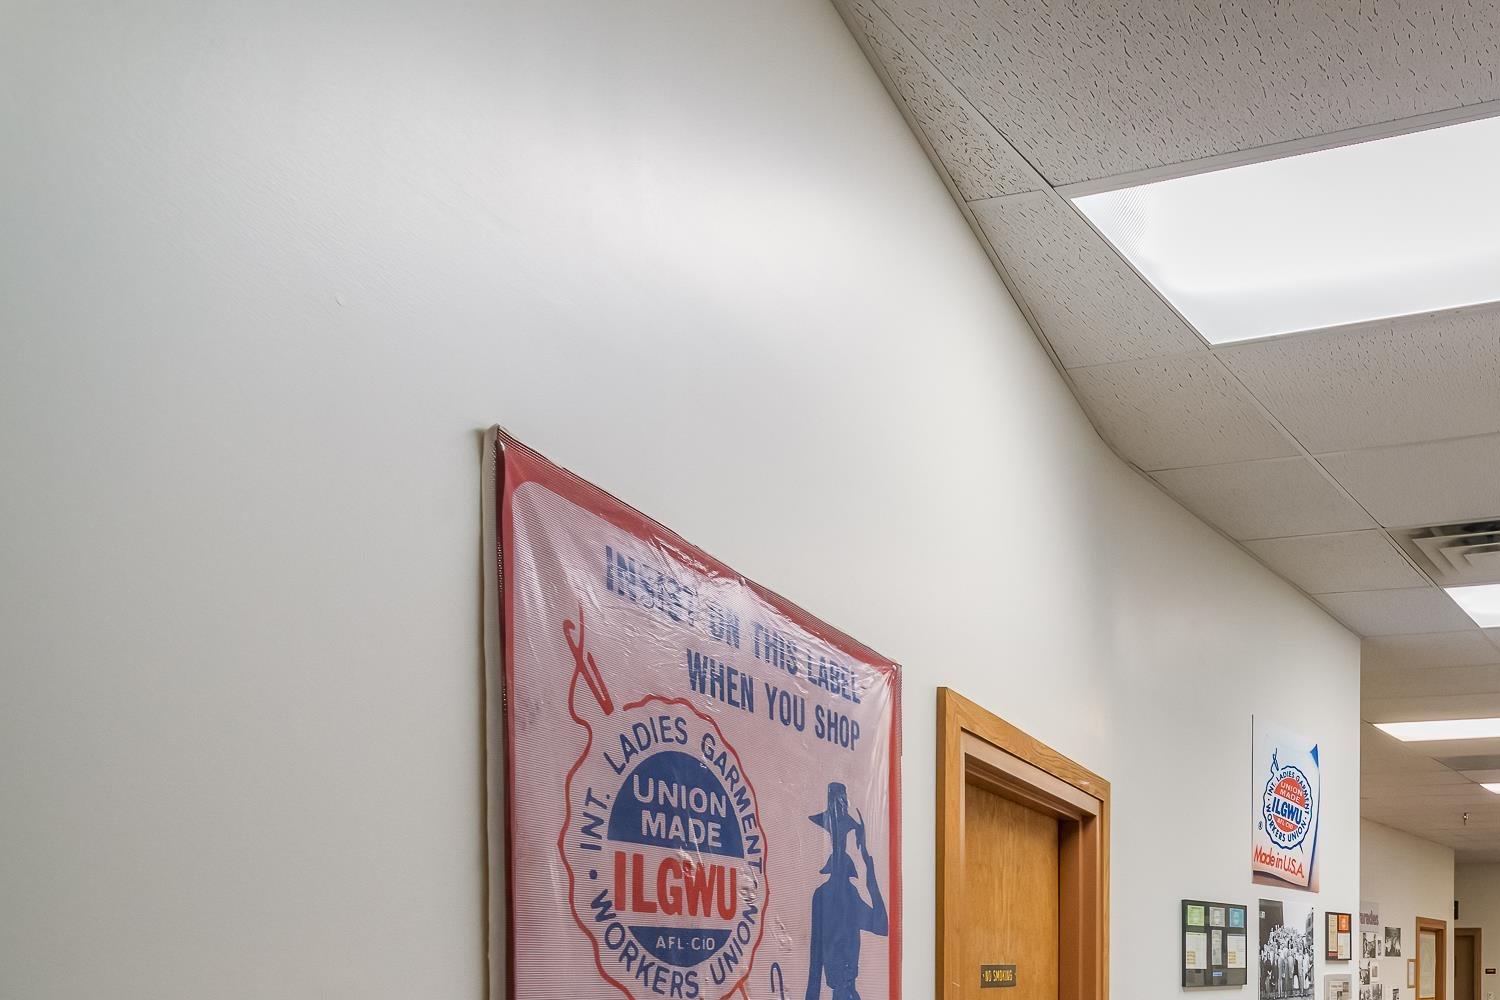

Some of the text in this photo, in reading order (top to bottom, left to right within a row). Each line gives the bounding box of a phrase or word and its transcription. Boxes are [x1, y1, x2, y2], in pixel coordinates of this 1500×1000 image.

[708, 603, 740, 650] ON
[753, 621, 799, 676] THIS
[807, 655, 862, 705] LABEL
[687, 648, 861, 751] WHEN YOU SHOP
[580, 715, 763, 875] INT. LADIES GARMENT
[633, 774, 728, 818] UNION
[1272, 796, 1303, 825] ILGWU
[1276, 770, 1295, 782] LADIES
[1296, 776, 1310, 815] GARMENT
[1279, 788, 1301, 803] MADE
[1280, 781, 1303, 797] UNION
[641, 809, 722, 848] MADE
[1265, 803, 1307, 842] WORKERS UNION
[1254, 845, 1275, 867] Made
[1275, 852, 1283, 869] in
[614, 850, 738, 921] ILGWU
[590, 888, 760, 1000] WORKERS UNION
